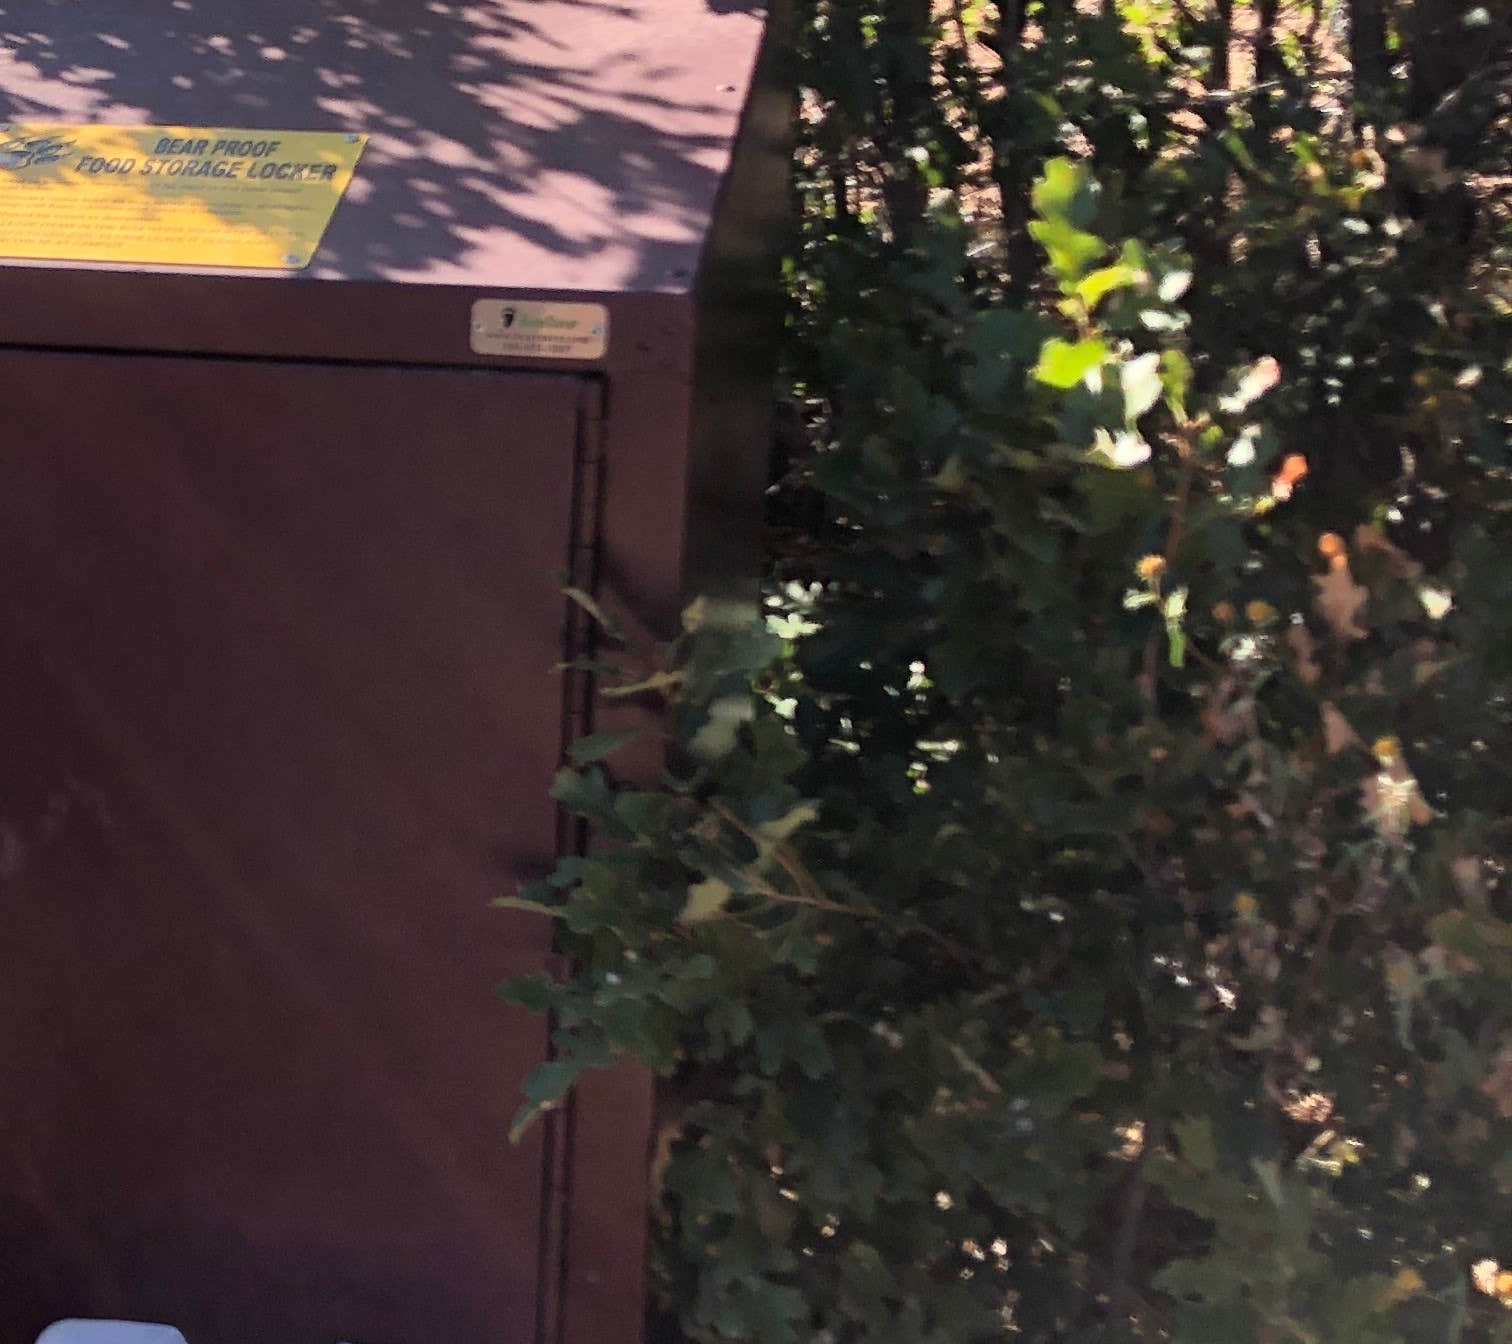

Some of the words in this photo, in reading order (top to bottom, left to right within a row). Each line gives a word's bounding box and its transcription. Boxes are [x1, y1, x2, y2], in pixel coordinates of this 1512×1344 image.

[154, 137, 209, 155] BEAR
[211, 140, 281, 157] PROOF
[74, 156, 136, 175] FOOD
[139, 159, 241, 179] STORAGE
[245, 162, 338, 182] LOCKER
